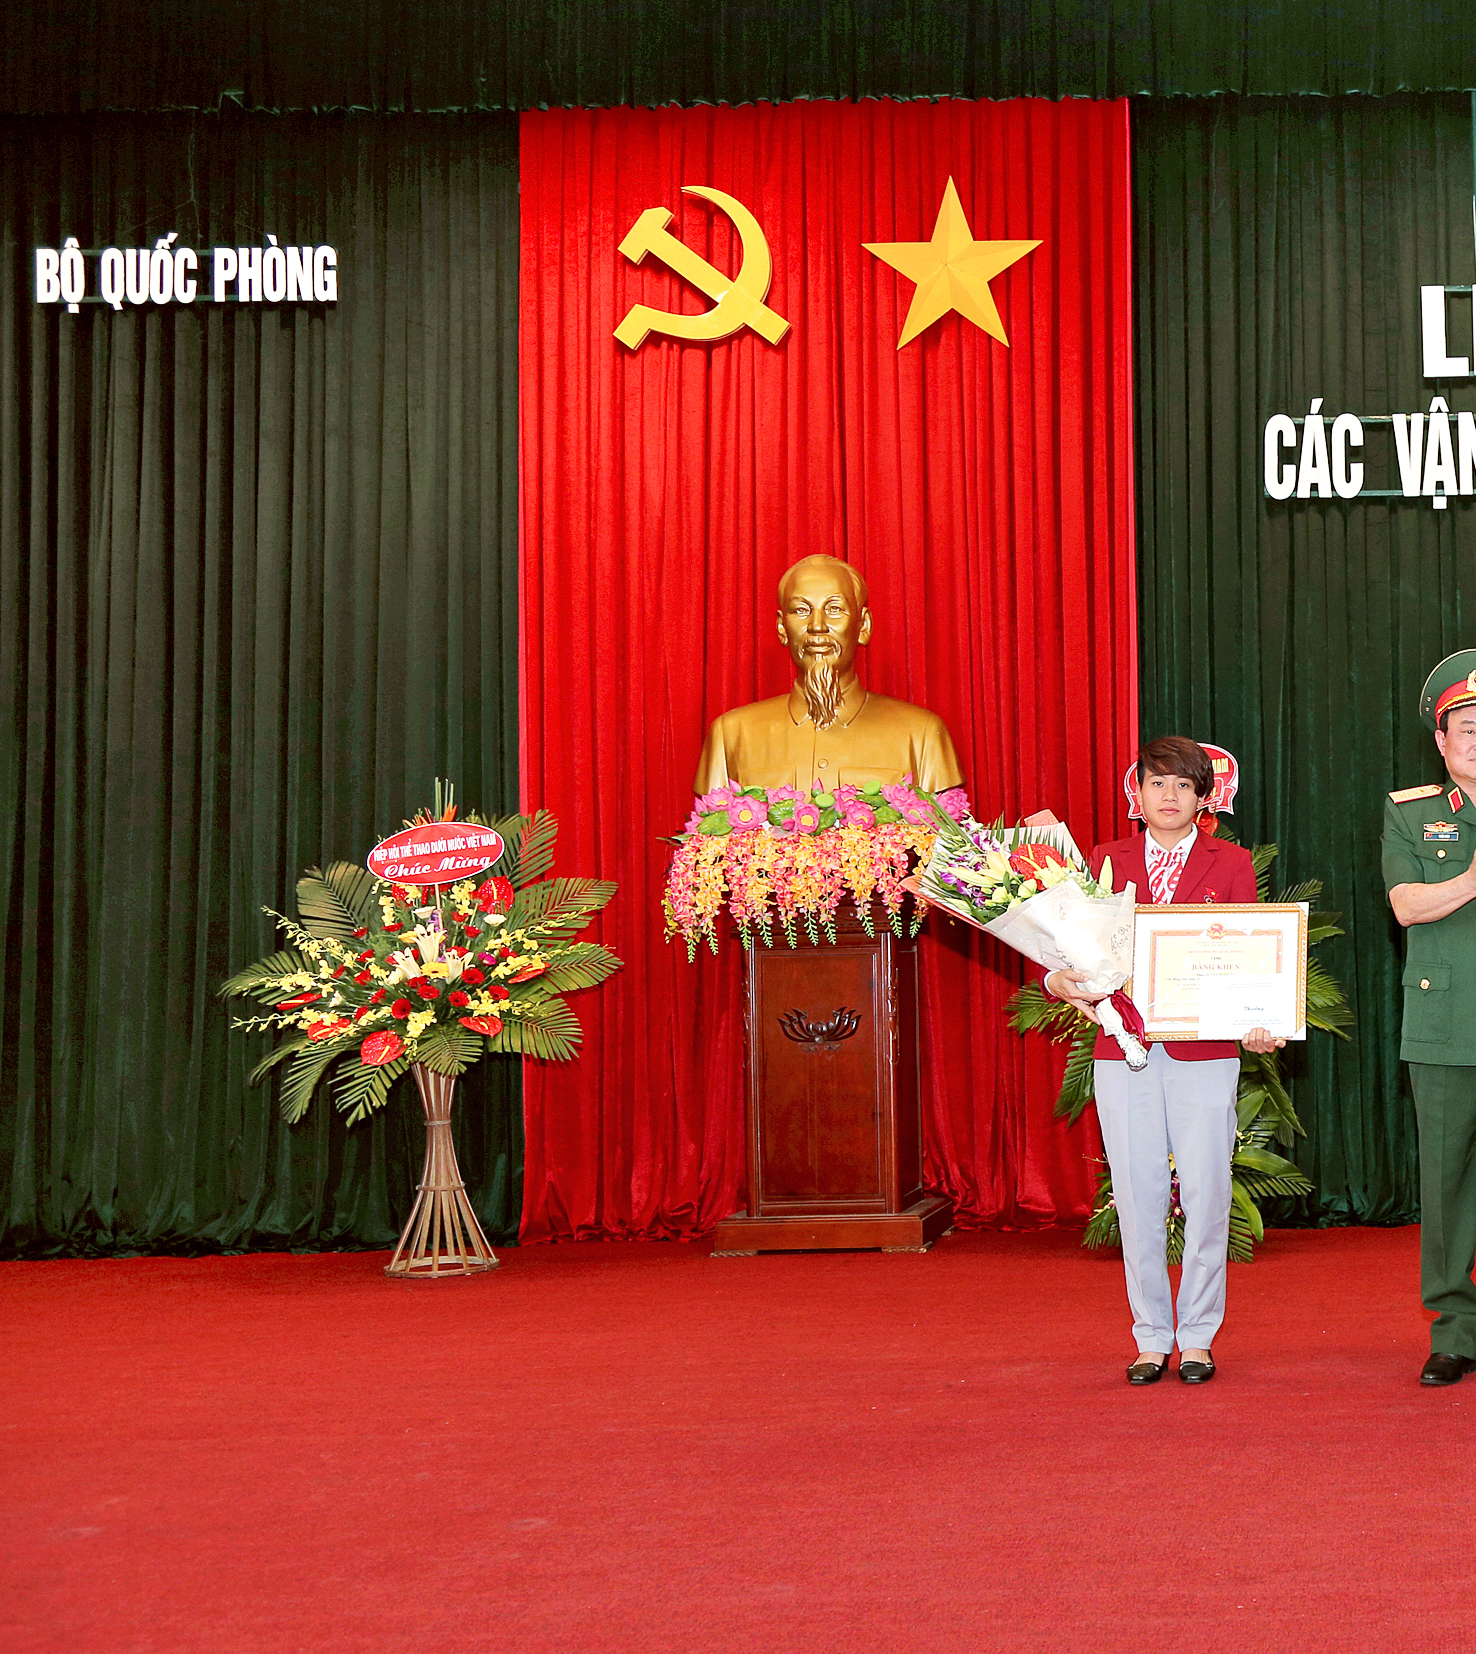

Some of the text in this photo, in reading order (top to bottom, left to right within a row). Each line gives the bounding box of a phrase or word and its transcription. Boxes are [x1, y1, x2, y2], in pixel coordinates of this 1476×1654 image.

[36, 232, 338, 313] BỘ QUỐC PHÒNG
[1264, 397, 1364, 499] CÁC
[384, 856, 492, 879] Chúc Mừng
[400, 838, 412, 858] THỂ
[413, 842, 431, 856] THAO
[466, 833, 480, 851] VIỆT
[480, 833, 497, 847] NAM
